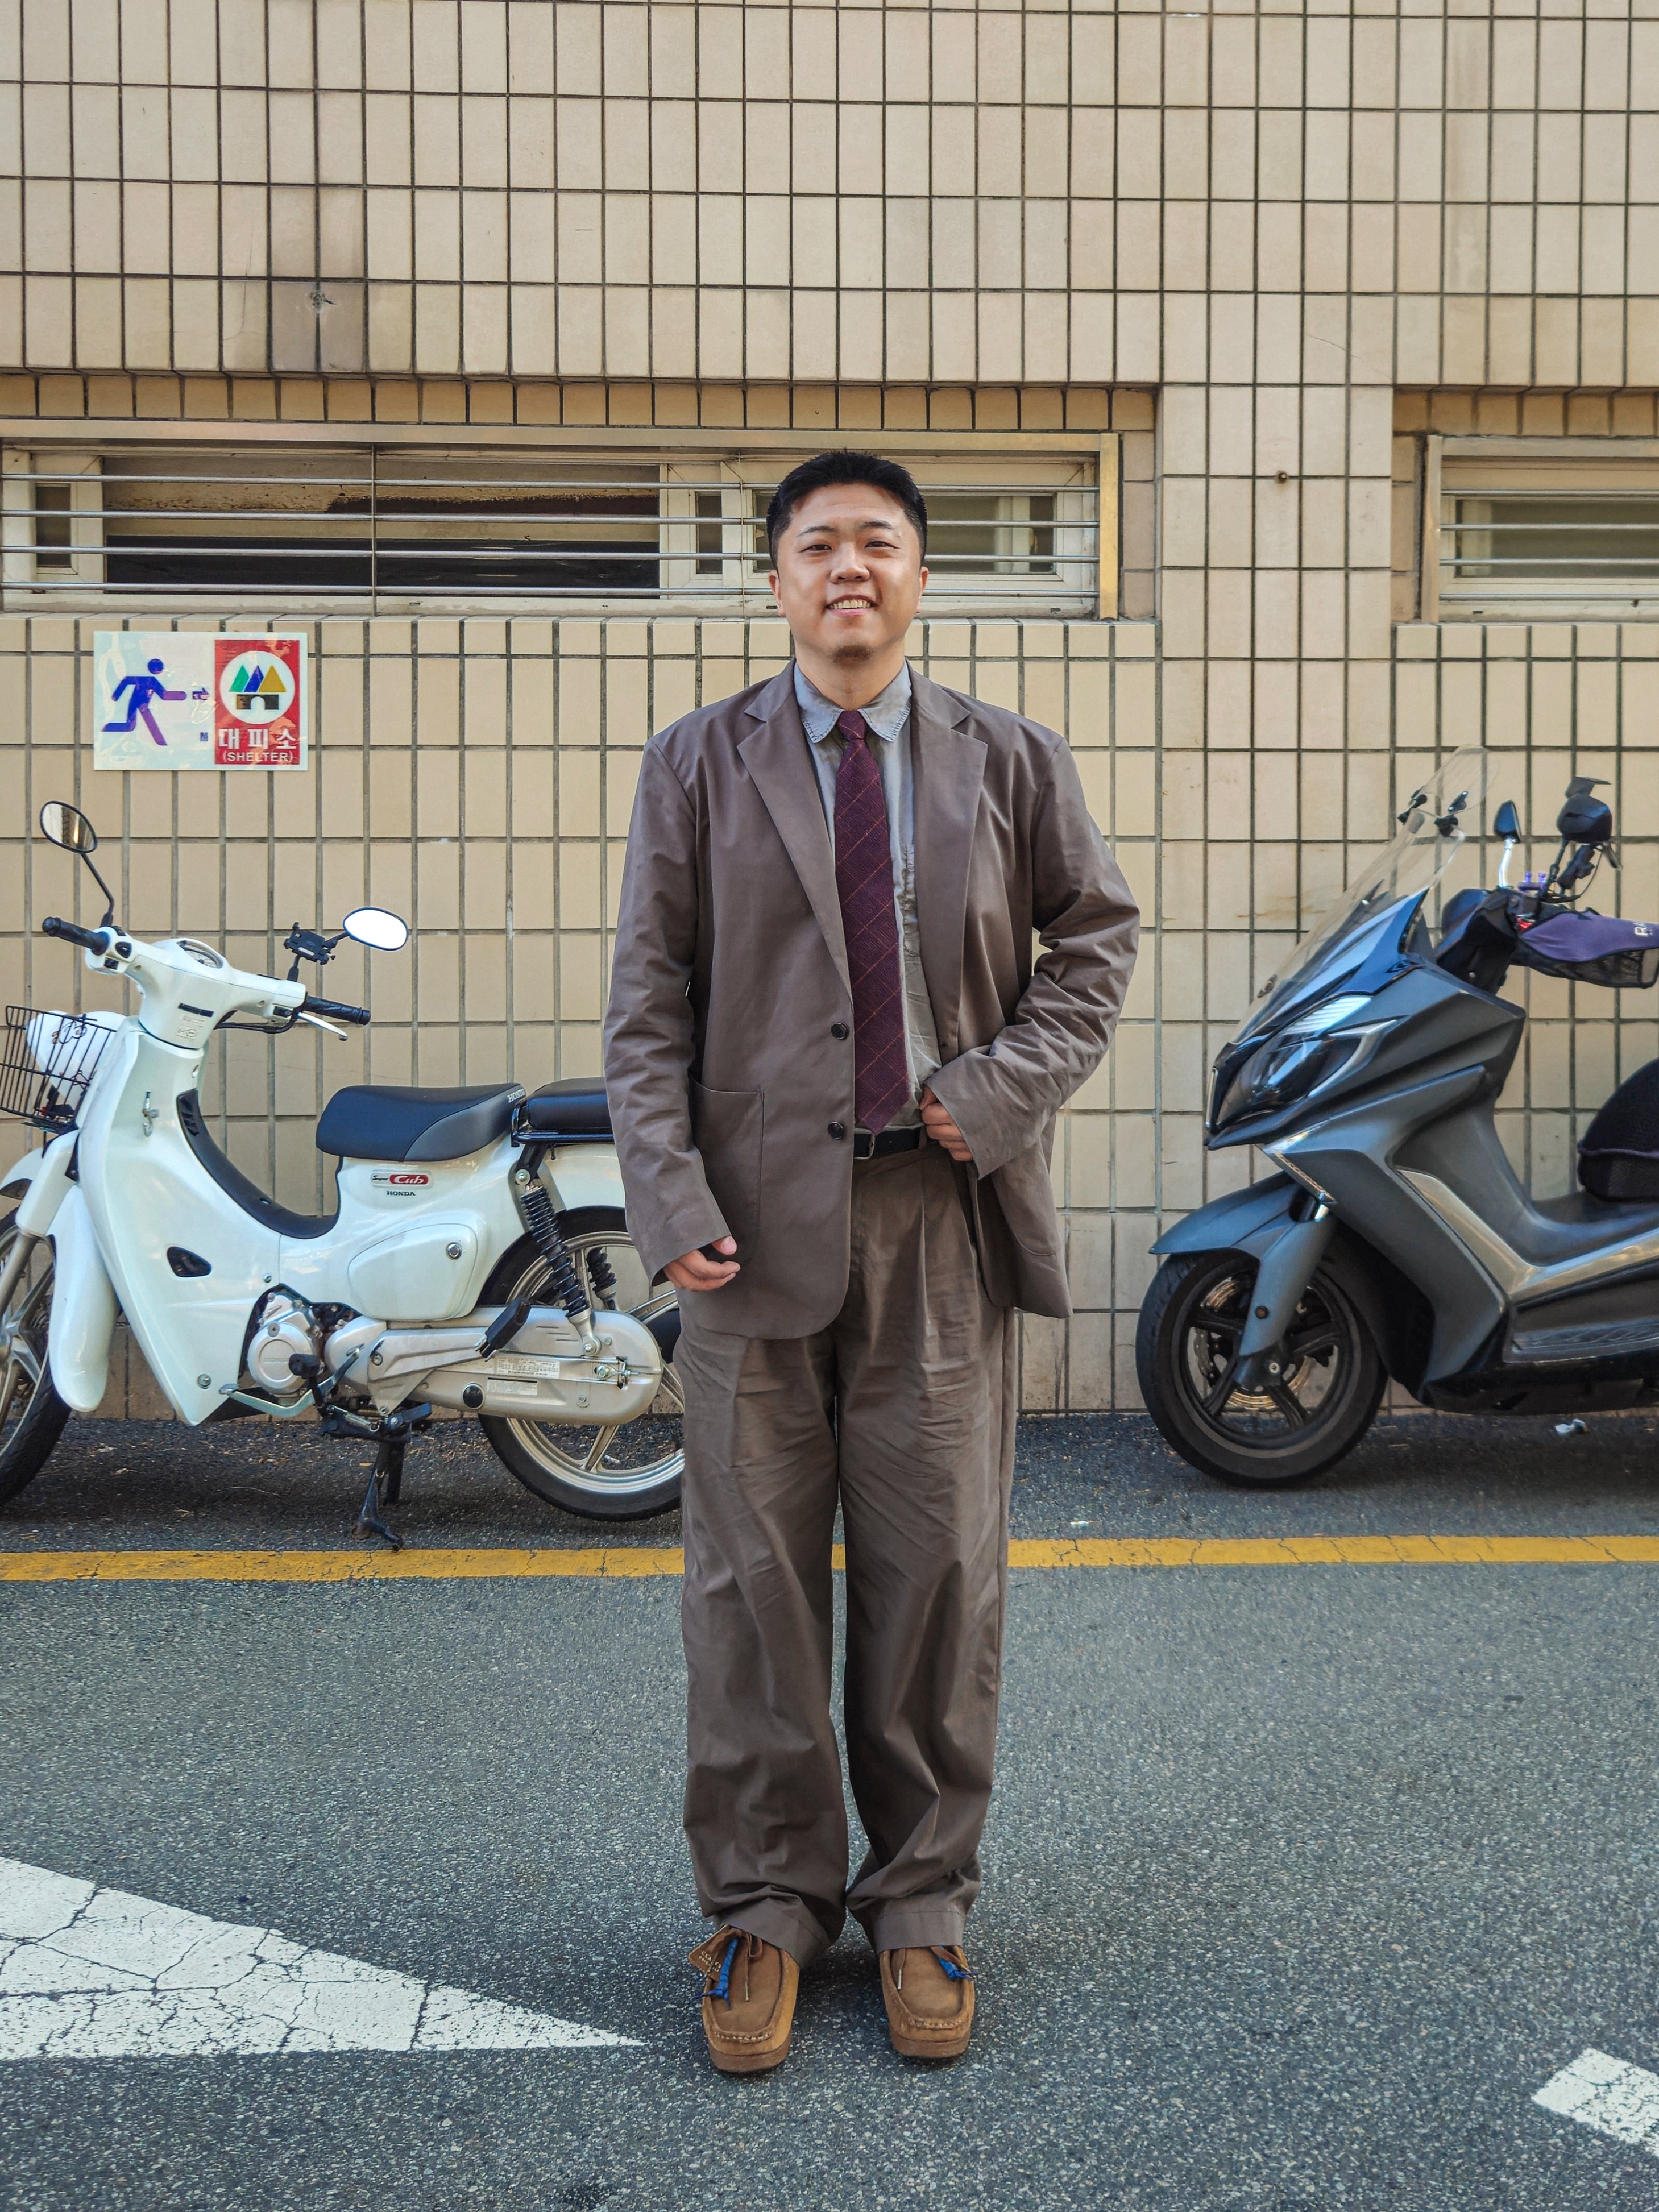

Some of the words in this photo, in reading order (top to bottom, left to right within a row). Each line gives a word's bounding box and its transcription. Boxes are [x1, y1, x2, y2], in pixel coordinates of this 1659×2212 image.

[219, 728, 297, 749] 대피소
[223, 750, 293, 762] (SHELTER)
[393, 1175, 425, 1184] Cub
